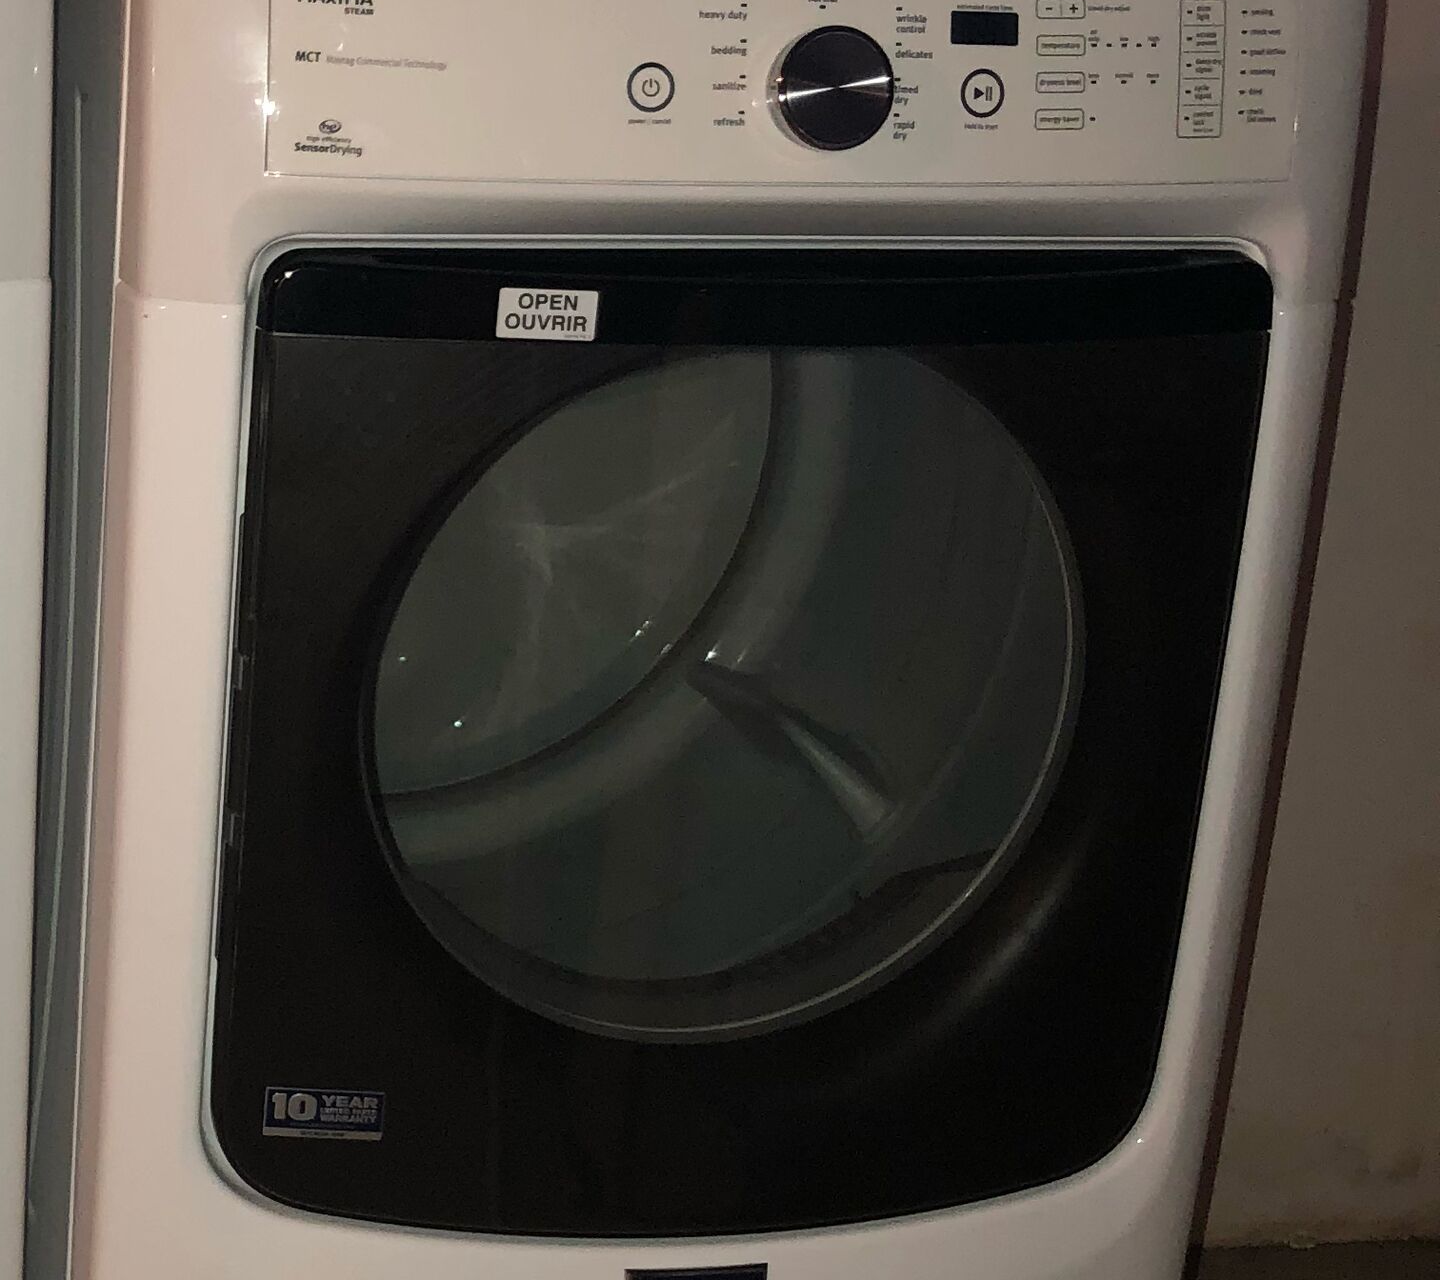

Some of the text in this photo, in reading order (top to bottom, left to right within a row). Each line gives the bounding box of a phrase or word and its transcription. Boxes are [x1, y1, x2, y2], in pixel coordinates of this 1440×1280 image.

[344, 7, 375, 16] STEAM
[699, 10, 748, 21] heavy duty
[896, 24, 926, 33] control
[295, 50, 321, 63] MCT
[711, 46, 747, 57] bedding
[895, 49, 933, 59] delicates
[713, 117, 745, 127] refresh
[294, 142, 363, 158] SensorDrying
[518, 292, 579, 311] OPEN
[504, 312, 588, 332] OUVRIR
[272, 1092, 378, 1121] 10 YEAR
